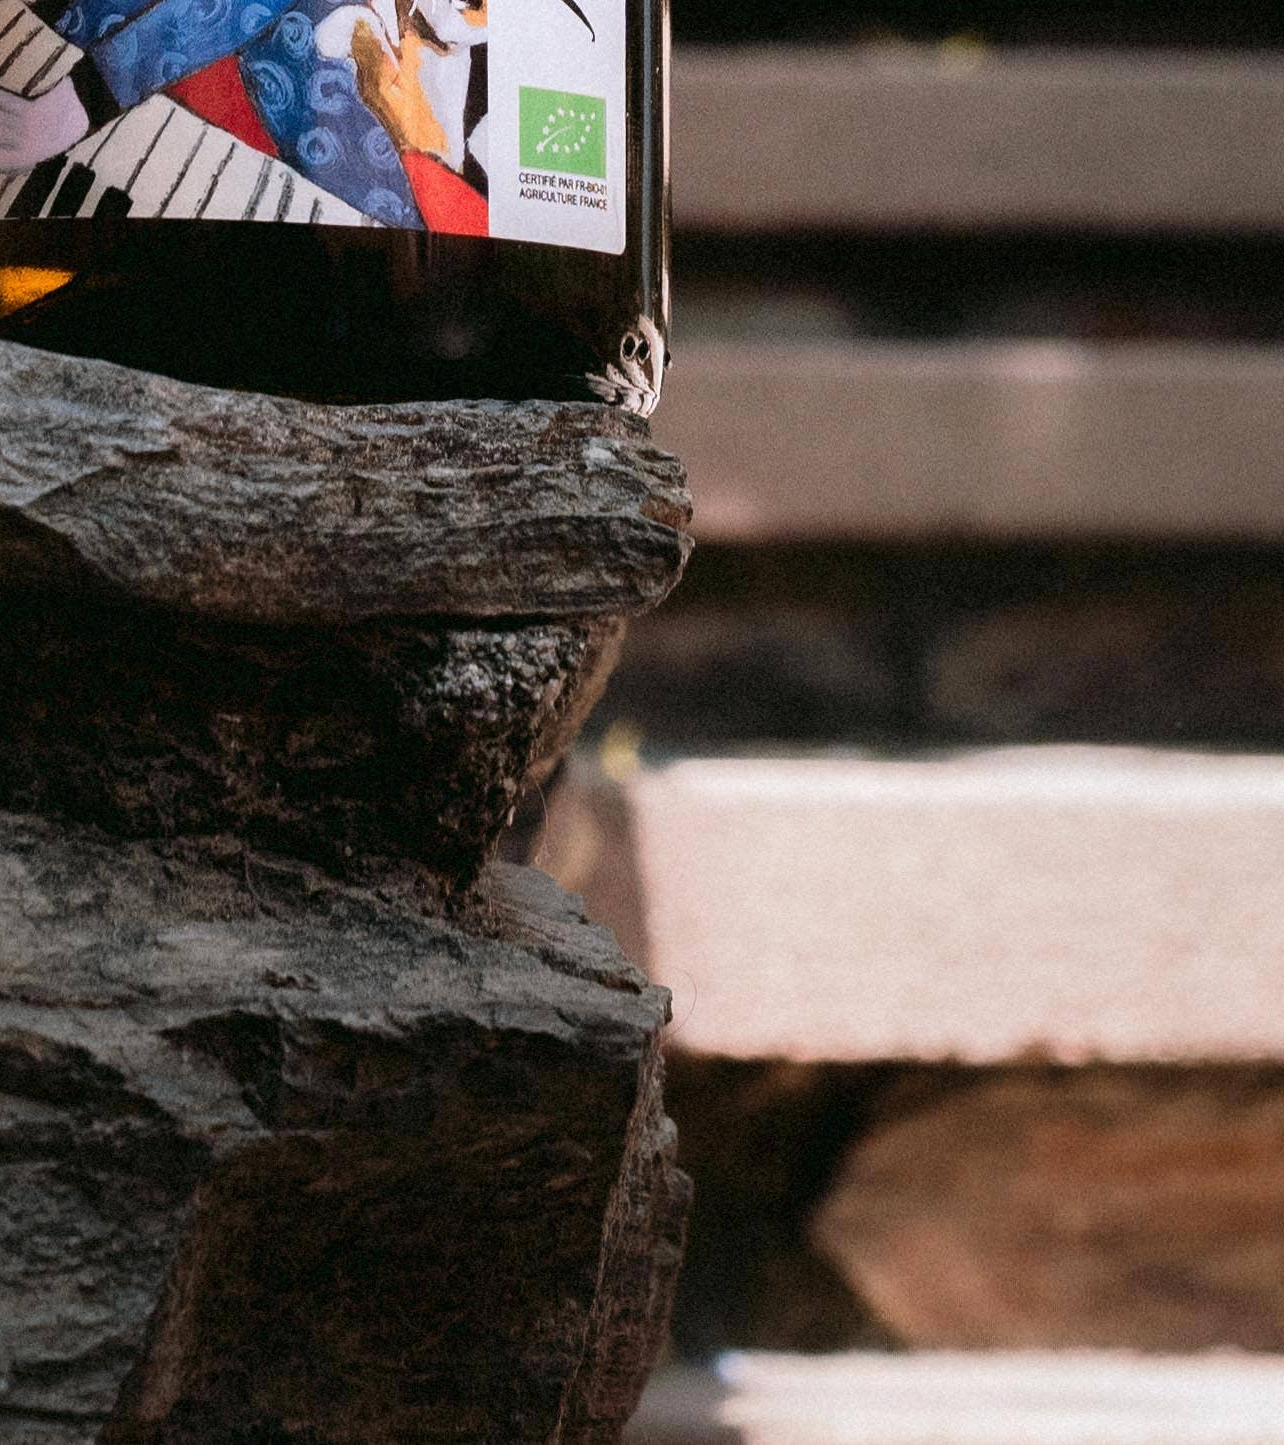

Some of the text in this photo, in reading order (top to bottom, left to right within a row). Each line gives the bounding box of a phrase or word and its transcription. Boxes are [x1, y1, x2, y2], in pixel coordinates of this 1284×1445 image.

[518, 172, 607, 196] CERTIFIÉ PAR FR-BIO-01
[519, 188, 607, 210] AGRICULTURE FRANCE
